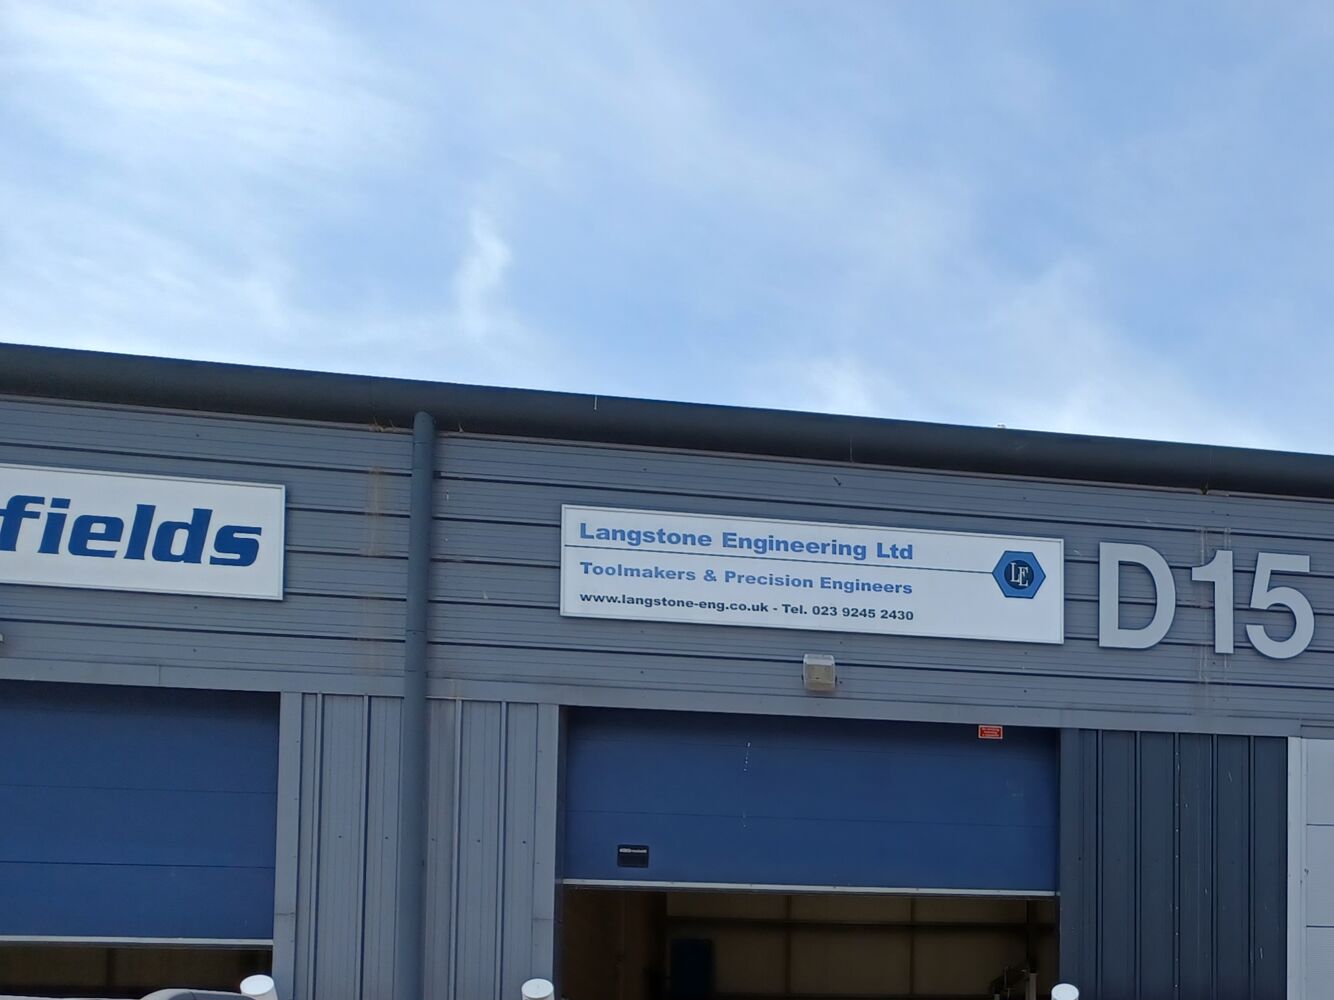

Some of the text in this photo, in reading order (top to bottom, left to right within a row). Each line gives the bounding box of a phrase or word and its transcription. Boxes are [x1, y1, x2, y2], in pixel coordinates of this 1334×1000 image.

[0, 494, 262, 567] fields
[580, 522, 913, 560] Langstone Engineering Ltd
[580, 561, 913, 594] Toolmakers & Precision Engineers
[580, 593, 769, 613] www.langstone-eng.co.uk
[782, 603, 808, 615] Tel.
[812, 605, 838, 617] 023
[842, 607, 876, 619] 9245
[880, 608, 914, 621] 2430
[1099, 541, 1315, 659] D15
